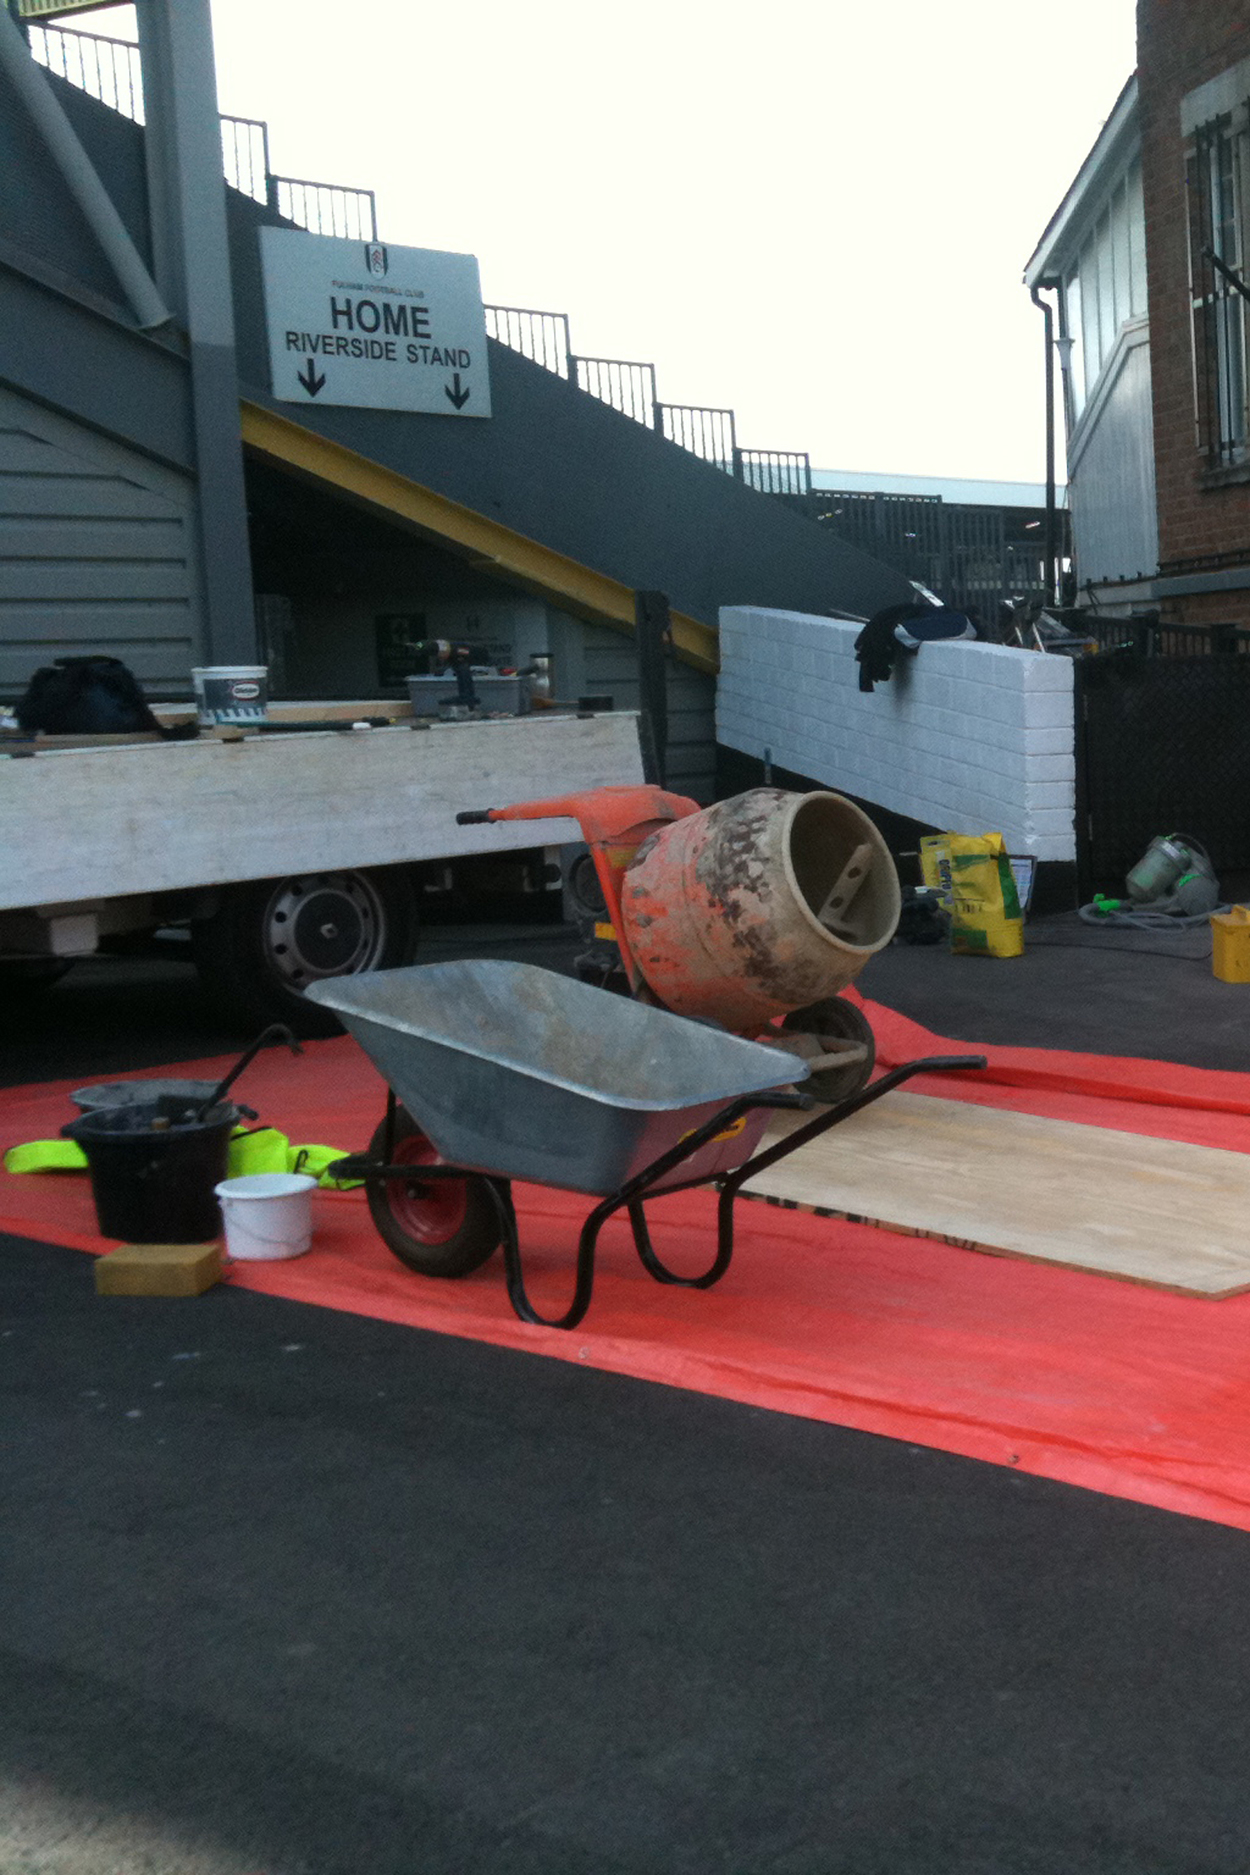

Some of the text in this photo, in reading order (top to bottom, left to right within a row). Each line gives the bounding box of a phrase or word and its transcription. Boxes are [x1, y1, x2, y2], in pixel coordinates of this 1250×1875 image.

[331, 297, 431, 339] HOME
[286, 332, 471, 369] RIVERSIDE STAND
